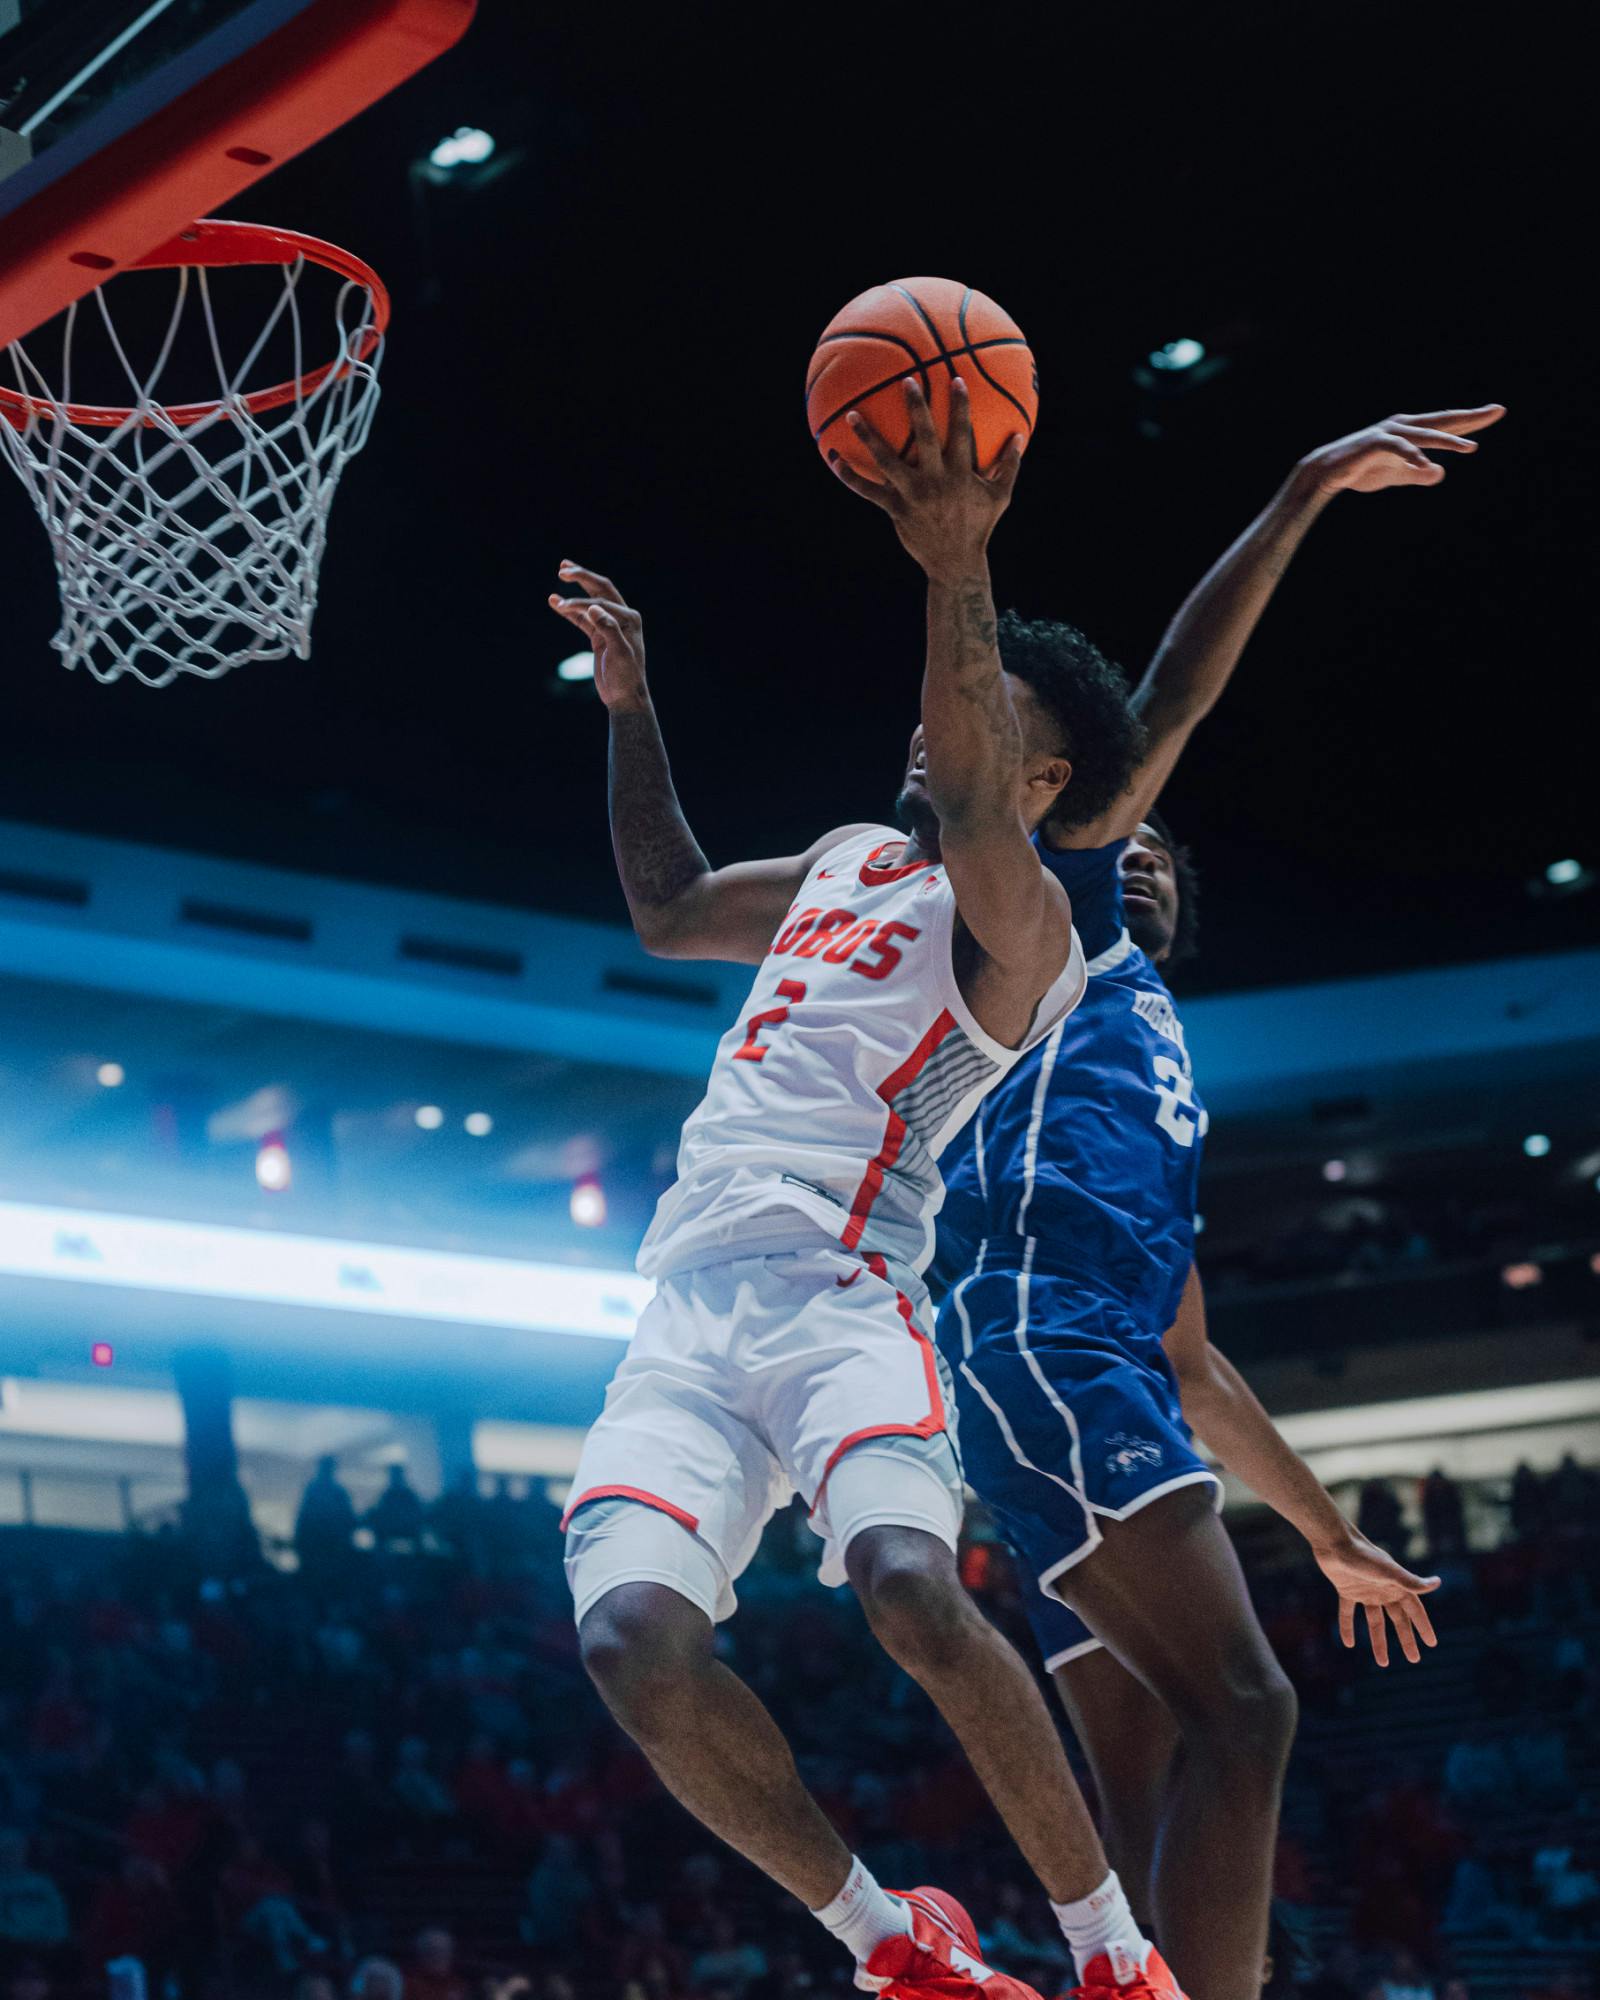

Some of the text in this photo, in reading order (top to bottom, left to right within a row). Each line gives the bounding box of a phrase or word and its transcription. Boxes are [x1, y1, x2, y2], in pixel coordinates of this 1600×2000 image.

[769, 903, 922, 981] OBOS
[732, 978, 807, 1063] 2
[1153, 1056, 1209, 1148] 2
